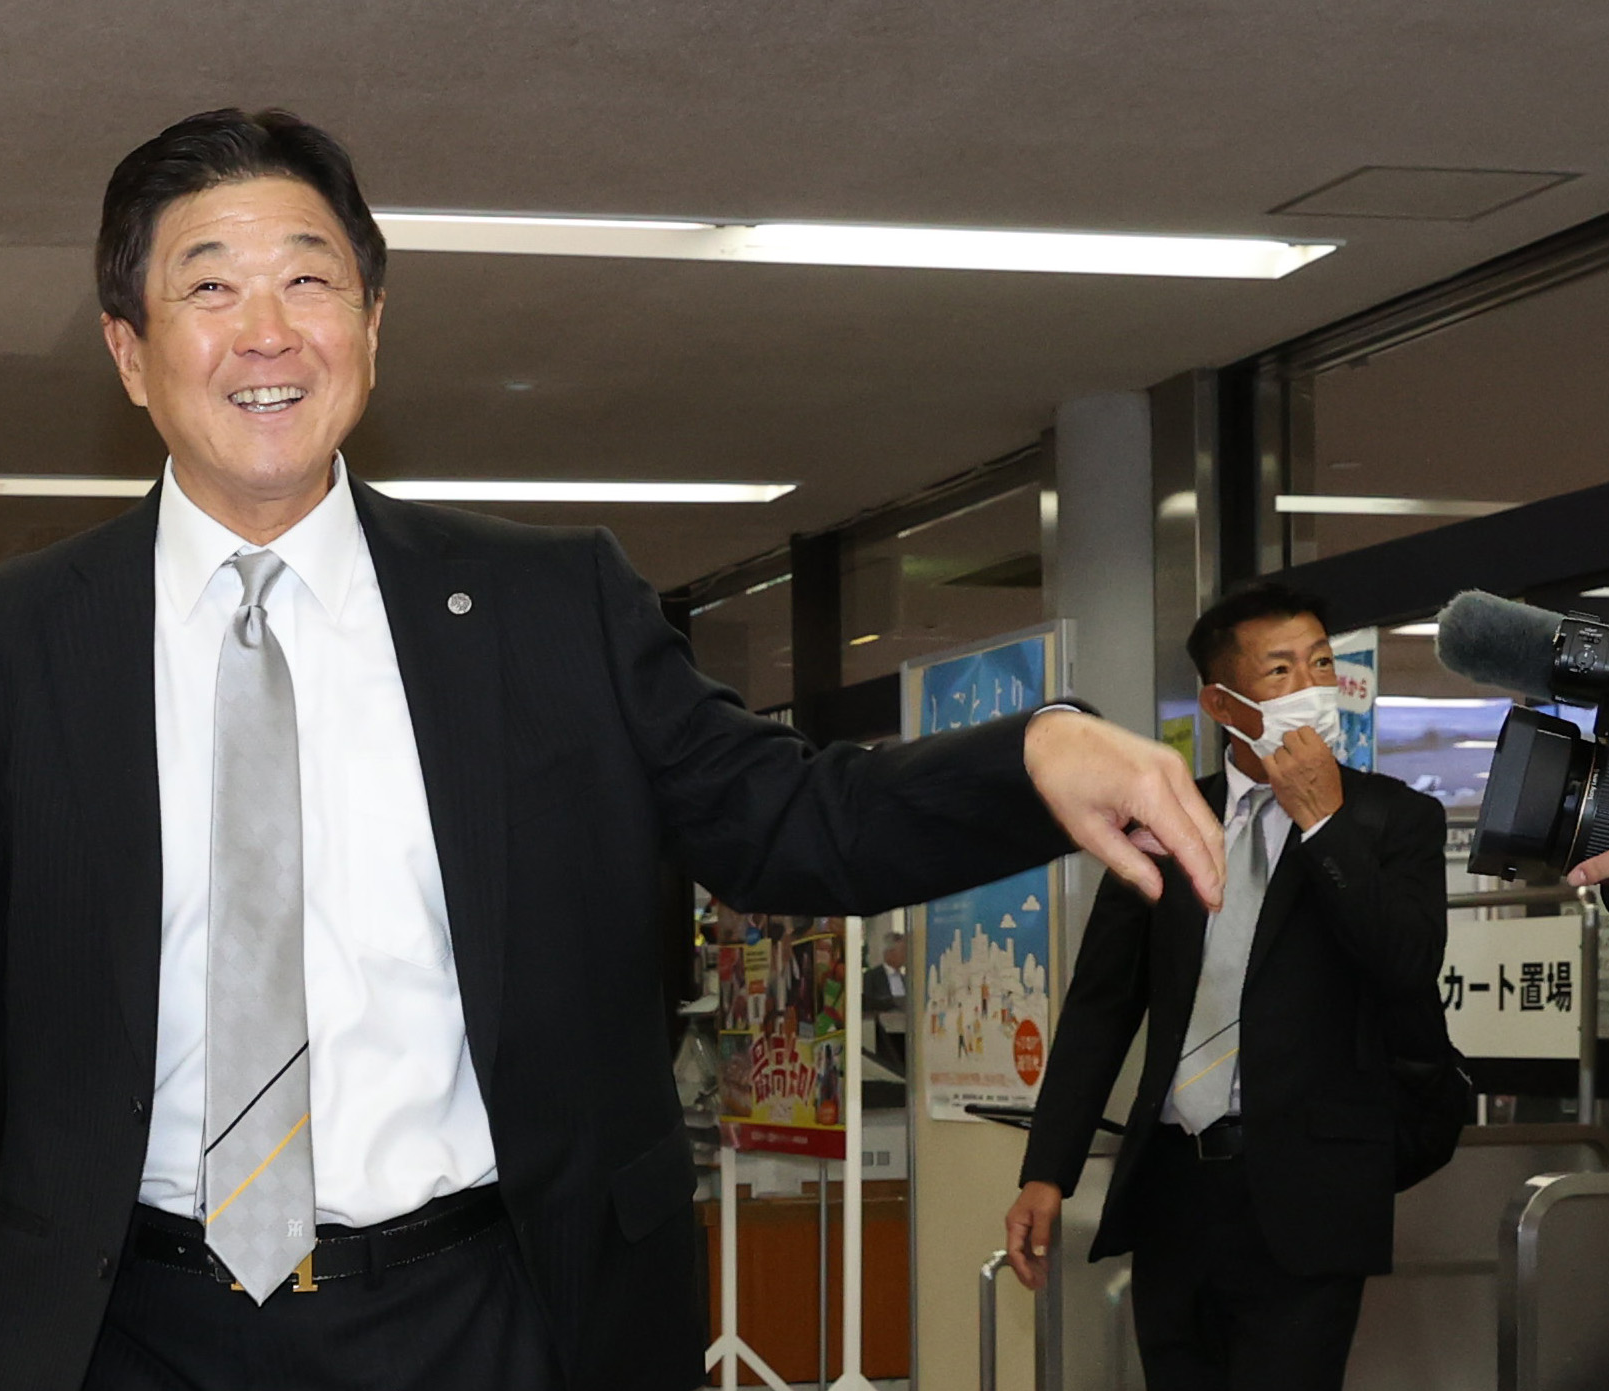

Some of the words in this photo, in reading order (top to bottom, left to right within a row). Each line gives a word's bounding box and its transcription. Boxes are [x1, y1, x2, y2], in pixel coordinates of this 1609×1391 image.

[1443, 961, 1573, 1013] カート置場
